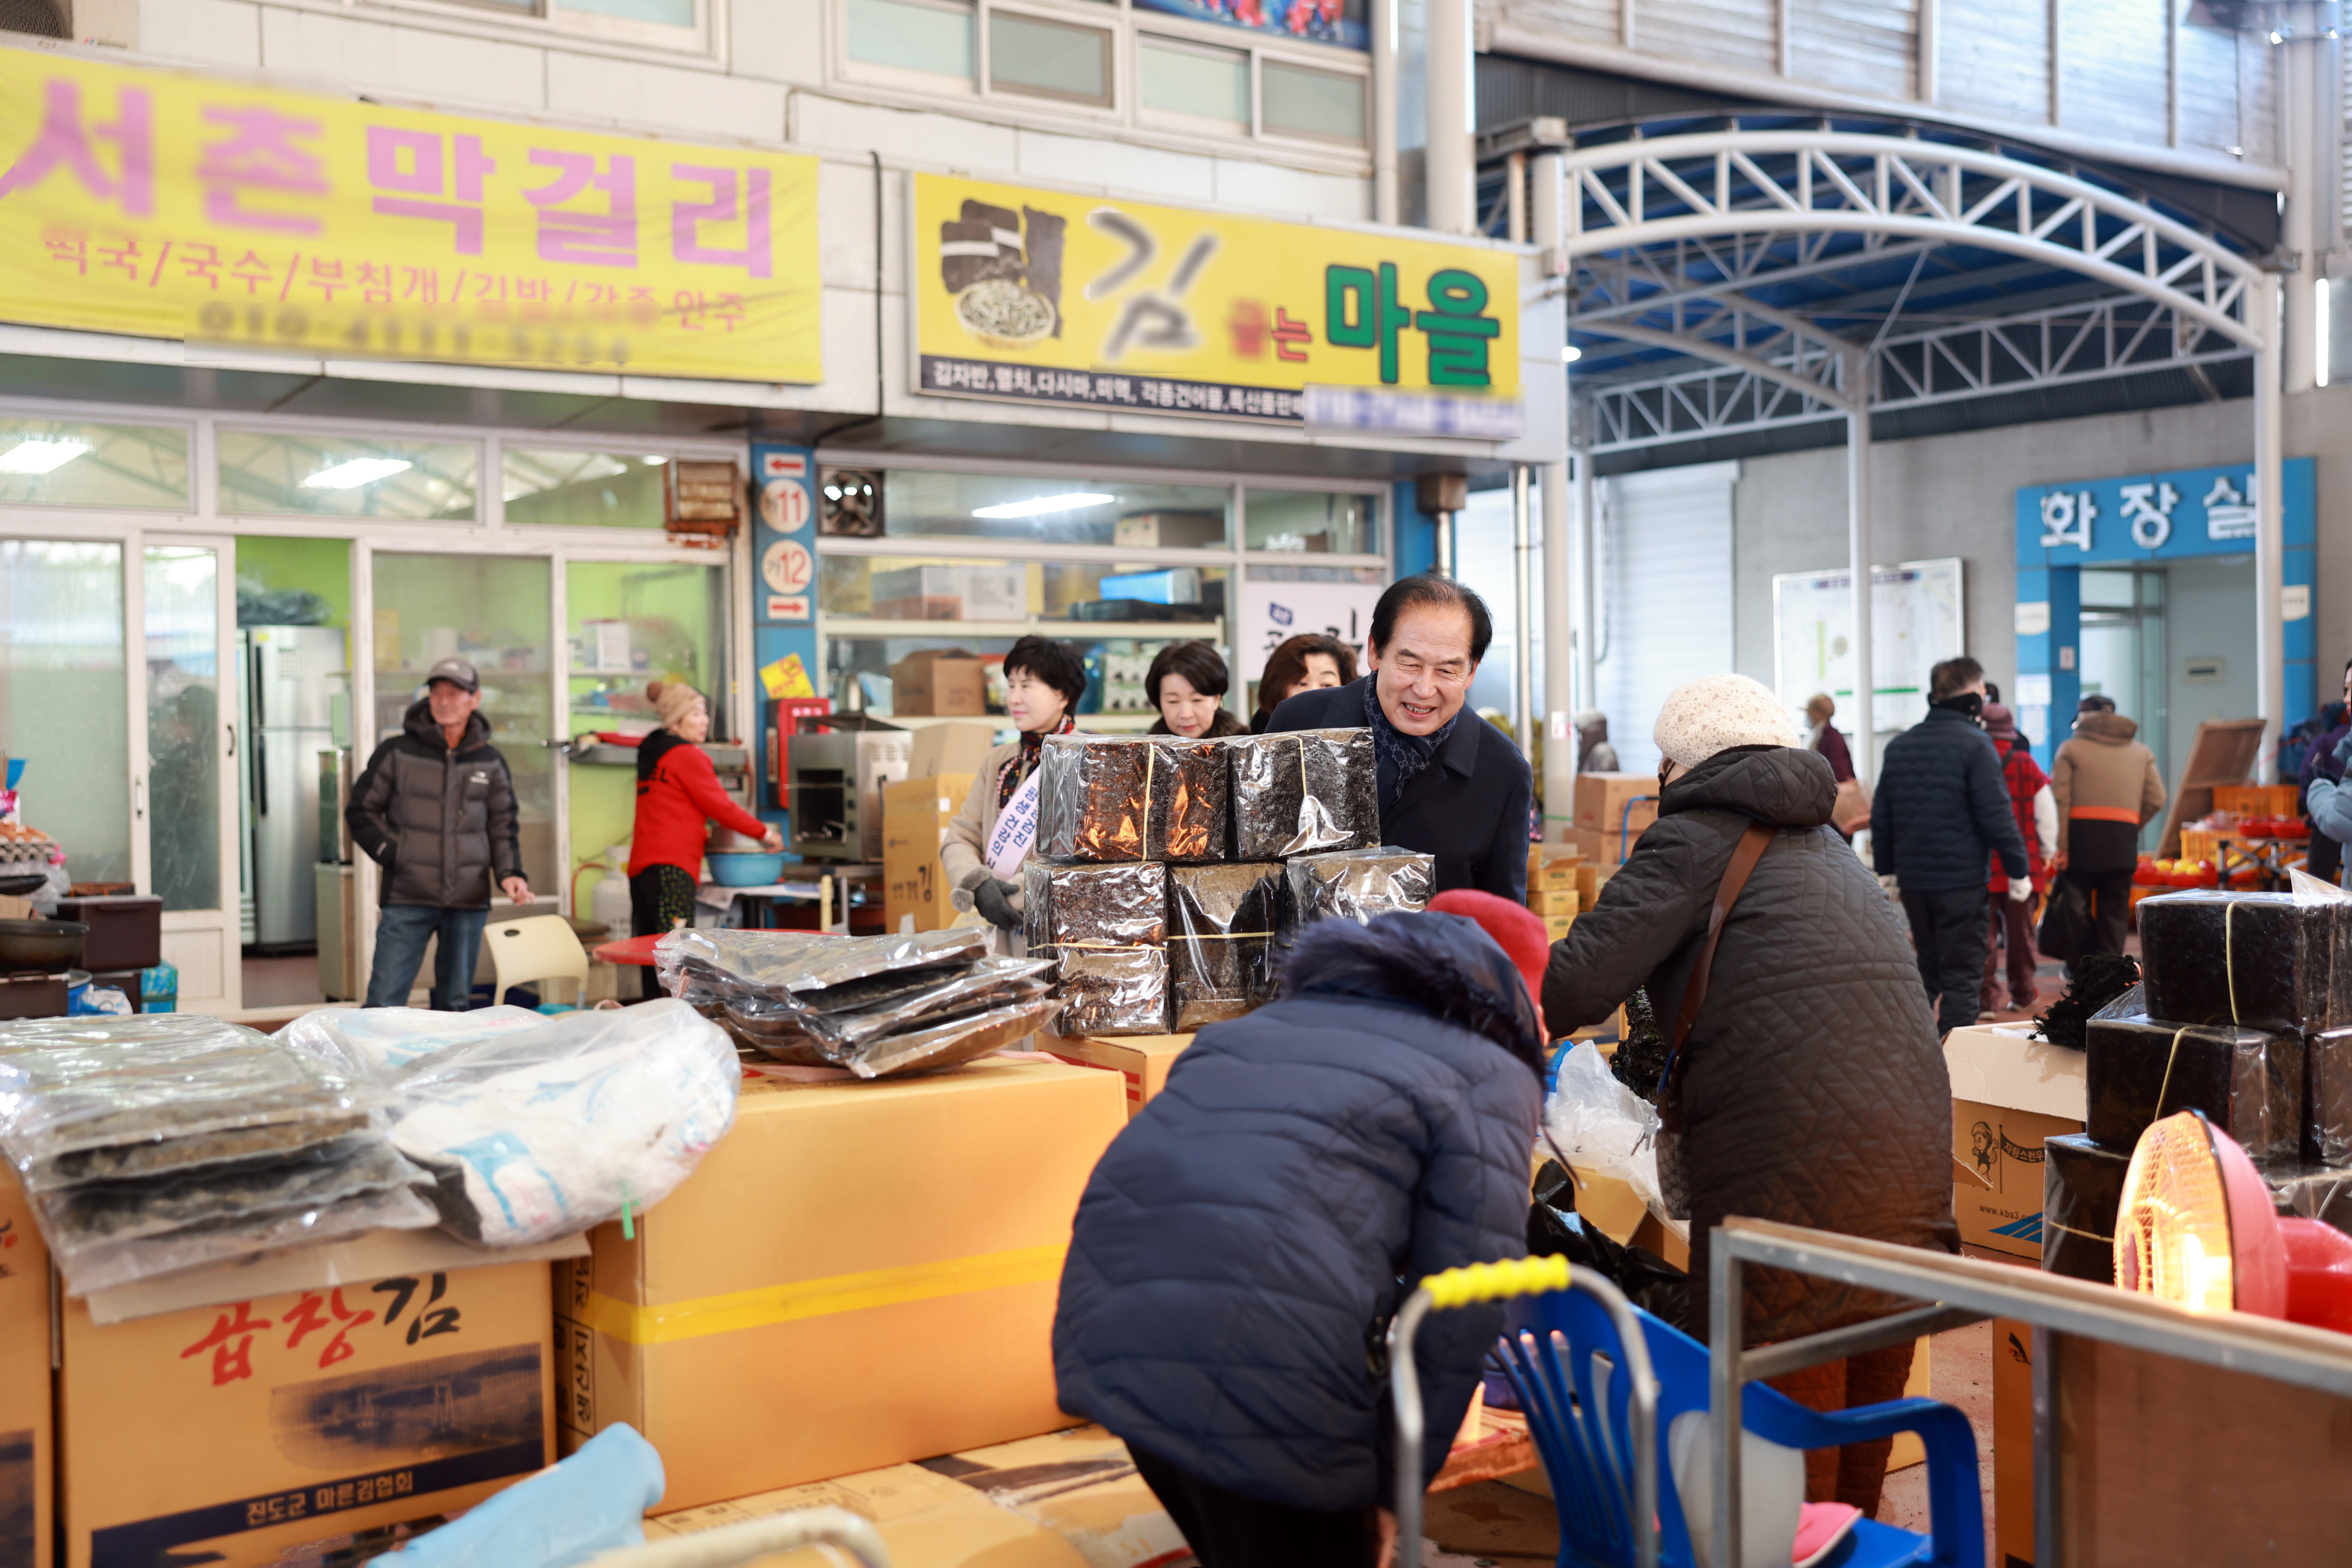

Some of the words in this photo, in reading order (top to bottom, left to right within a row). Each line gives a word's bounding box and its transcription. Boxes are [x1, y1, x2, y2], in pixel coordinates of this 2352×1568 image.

[673, 290, 746, 332] 안주
[1323, 260, 1501, 388] 마을
[2040, 473, 2257, 552] 화장실
[1979, 1205, 2038, 1224] www.kbs3.com
[246, 1492, 307, 1526] 진도군
